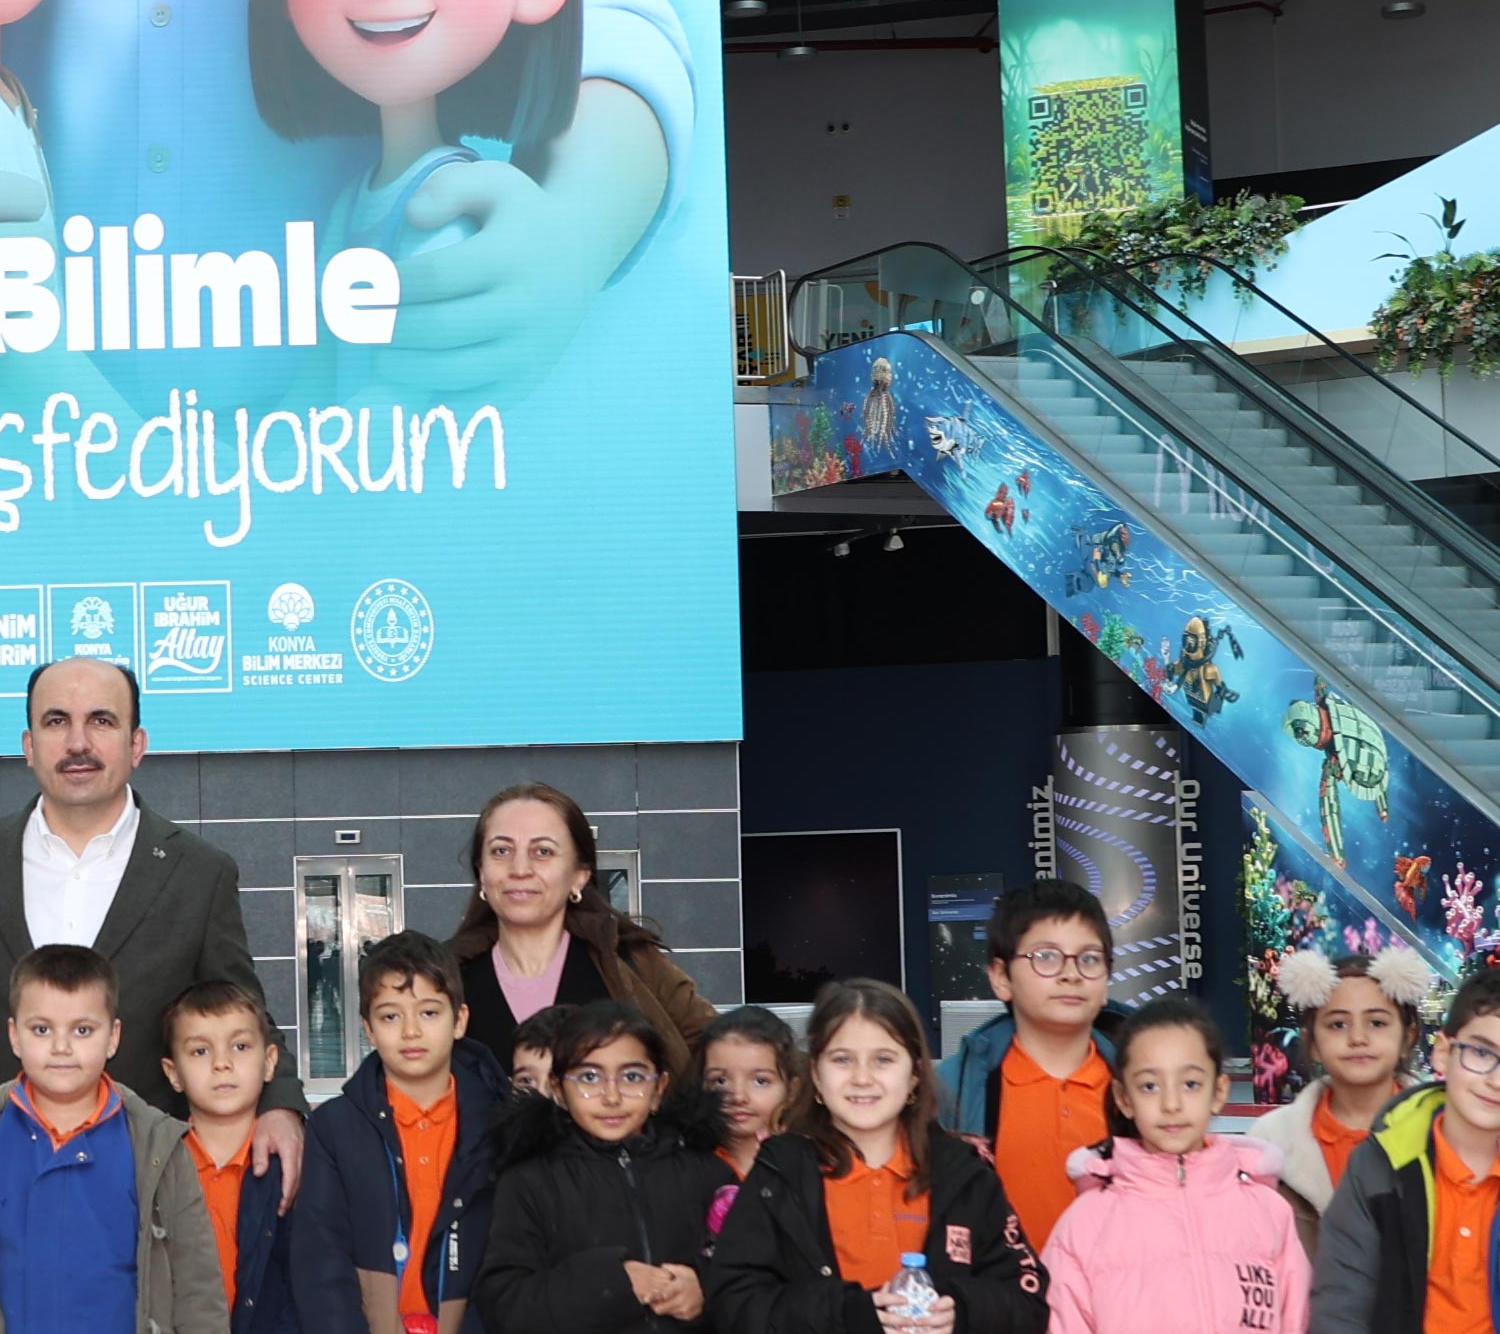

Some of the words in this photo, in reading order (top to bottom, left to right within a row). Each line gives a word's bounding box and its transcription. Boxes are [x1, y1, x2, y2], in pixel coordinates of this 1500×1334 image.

[163, 592, 209, 612] UĞUR
[74, 643, 113, 656] KONYA
[150, 627, 226, 663] Altay
[268, 636, 316, 652] KONYA
[242, 655, 281, 671] BİLİM
[283, 653, 343, 670] MERKEZİ
[242, 674, 294, 686] SCIENCE
[297, 673, 343, 685] CENTER
[1178, 779, 1201, 832] Our
[1027, 784, 1056, 880] enimiz
[1179, 842, 1206, 979] Universe
[1235, 1263, 1274, 1286] LIKE
[1240, 1284, 1273, 1308] YOU
